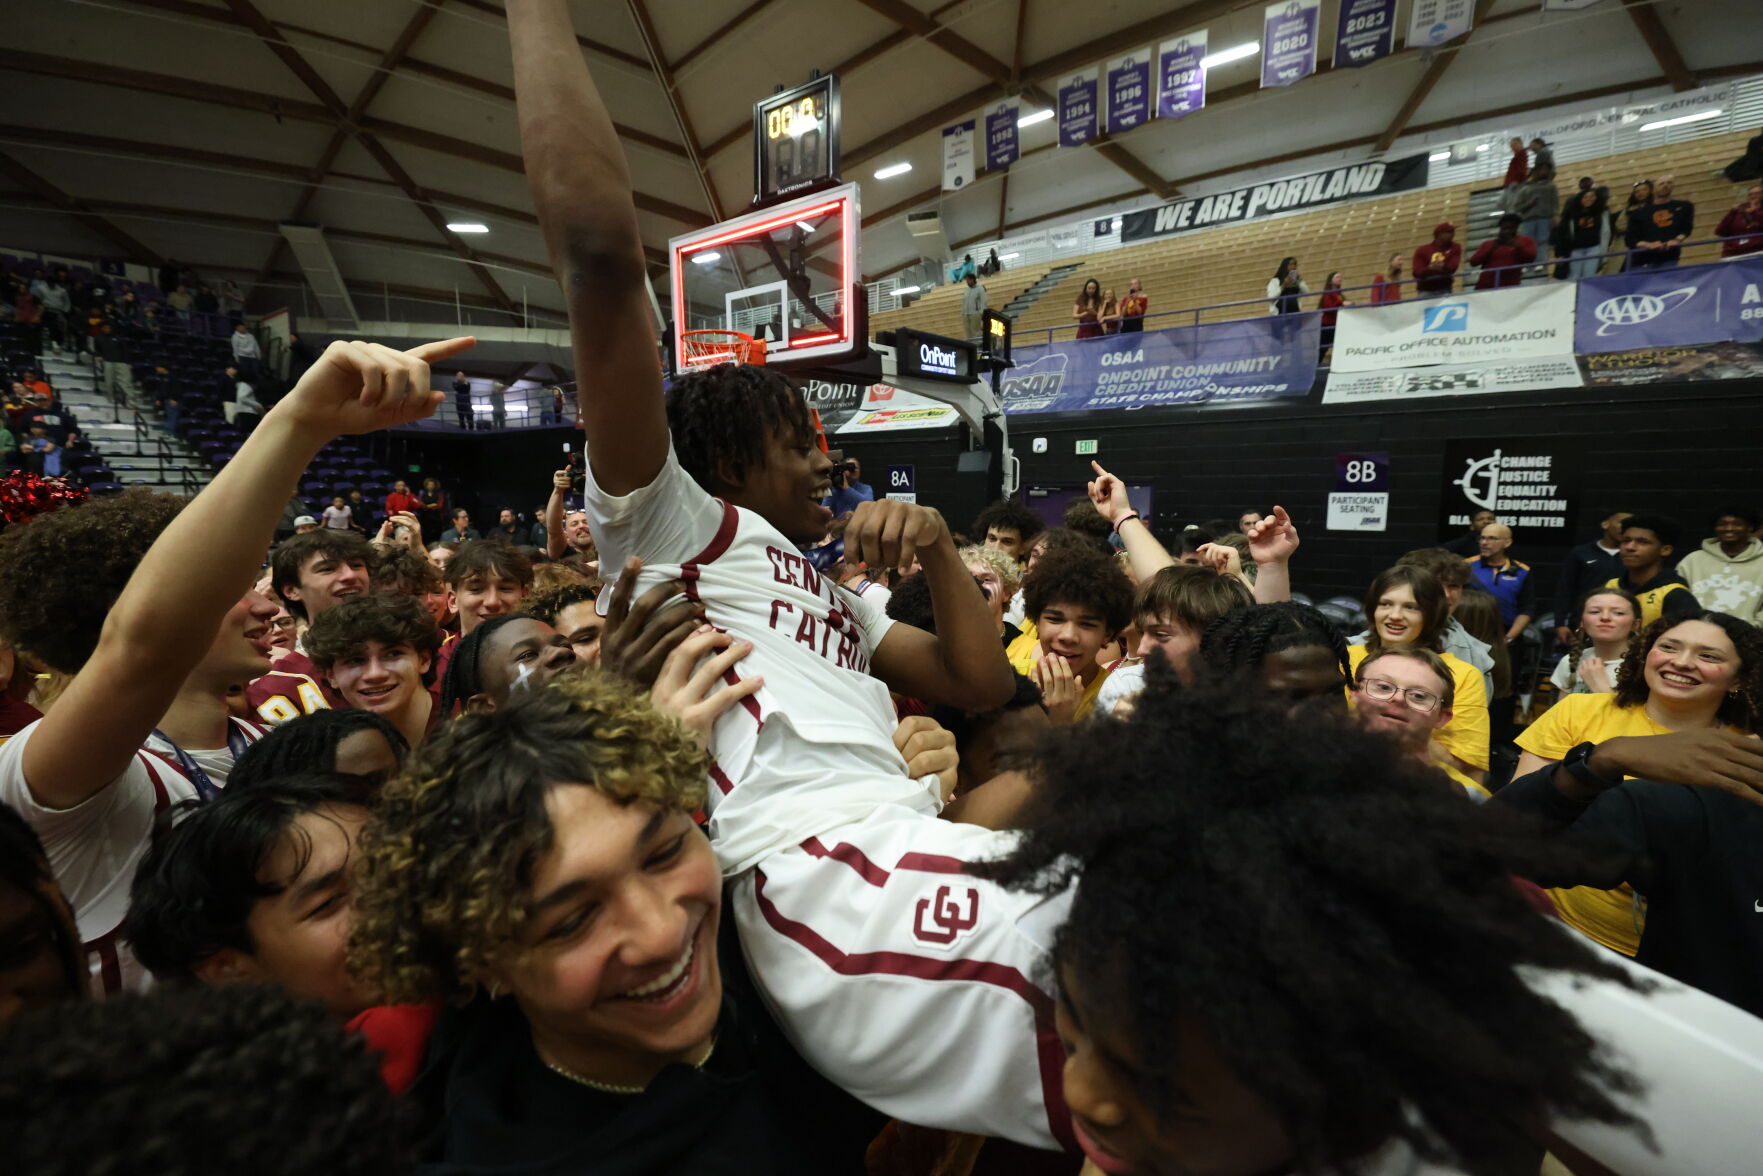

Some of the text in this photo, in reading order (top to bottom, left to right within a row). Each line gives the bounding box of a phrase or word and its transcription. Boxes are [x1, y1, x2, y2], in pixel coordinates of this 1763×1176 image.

[1346, 11, 1386, 34] 2023
[1272, 33, 1308, 56] 2020
[1167, 69, 1196, 88] 1997
[1115, 84, 1142, 104] 1996
[1660, 91, 1728, 113] CATHOLIC
[1065, 101, 1091, 121] 1994
[1154, 162, 1387, 232] WE ARE PORTLAND
[1602, 295, 1656, 323] AAA
[1345, 328, 1557, 357] PACIFIC OFFICE AUTOMATION
[920, 343, 956, 368] OnPoint
[1101, 349, 1144, 367] OSAA
[1099, 355, 1283, 385] ONPOINT COMMUNITY
[800, 380, 857, 401] nPoint
[1001, 371, 1064, 399] OSAA
[1088, 383, 1289, 405] STATE CHAMPONSHIPS
[1095, 377, 1212, 396] CREDIT UNION
[1080, 441, 1094, 453] EXIT
[1345, 460, 1376, 483] 8B
[1500, 456, 1552, 468] CHANGE
[891, 470, 909, 487] 8A
[1499, 470, 1550, 482] JUSTICE
[1331, 496, 1385, 506] PARTICIPANT
[1497, 485, 1558, 497] EQUALITY
[1339, 504, 1375, 514] SEATING
[1496, 499, 1567, 511] EDUCATION
[1449, 515, 1565, 528] BLA VES MATTER
